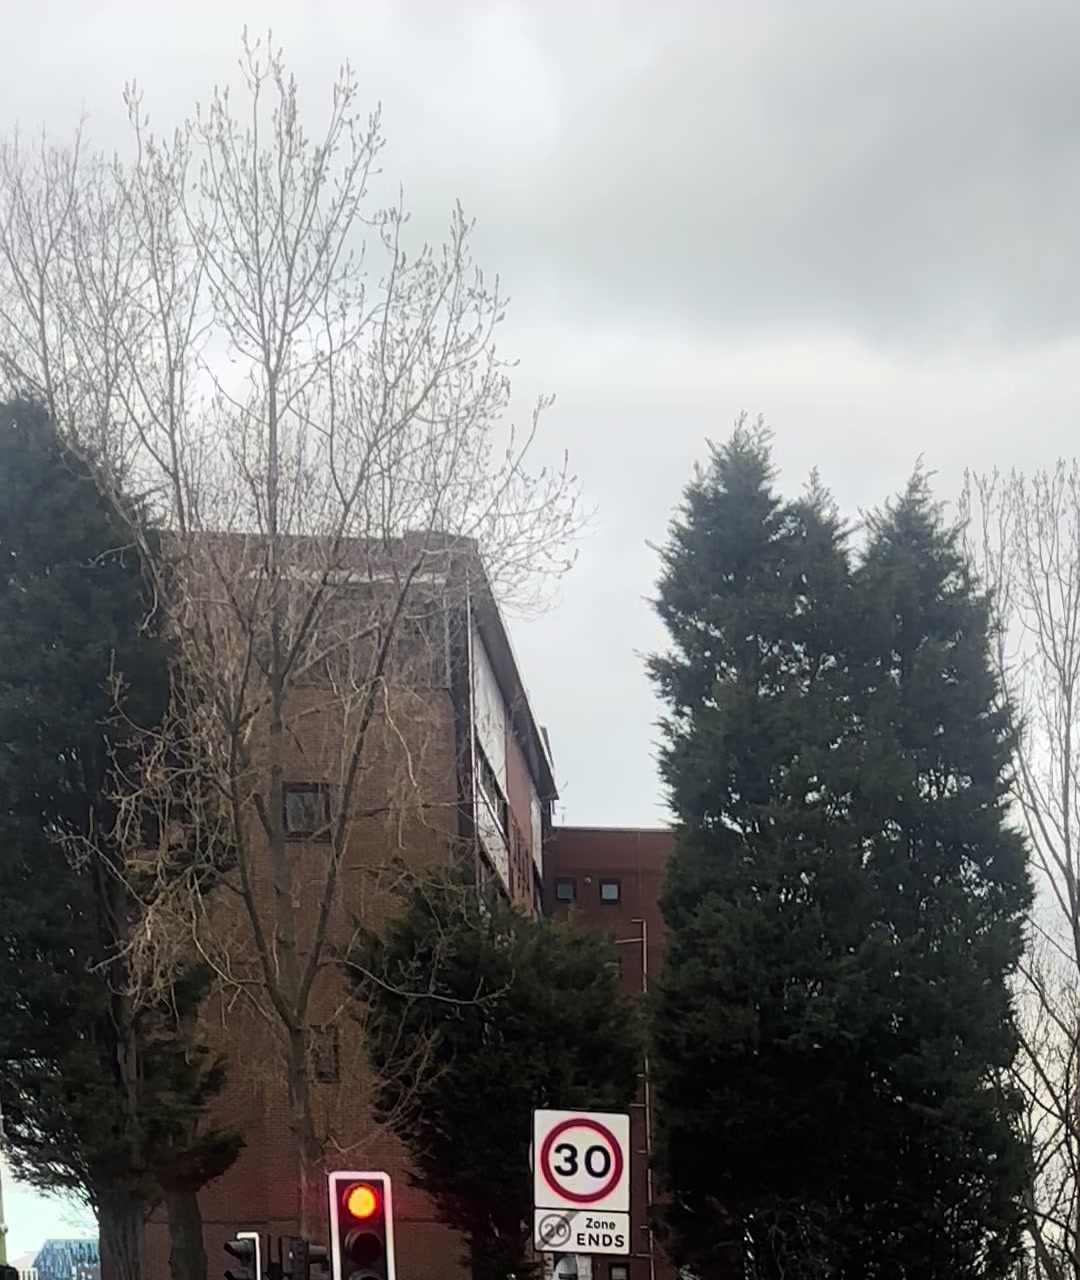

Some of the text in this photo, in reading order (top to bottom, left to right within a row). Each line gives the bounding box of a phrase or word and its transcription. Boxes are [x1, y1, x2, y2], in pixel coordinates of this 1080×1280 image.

[554, 1143, 611, 1178] 30
[544, 1223, 567, 1238] 20
[585, 1217, 616, 1230] Zone
[577, 1233, 624, 1247] ENDS
